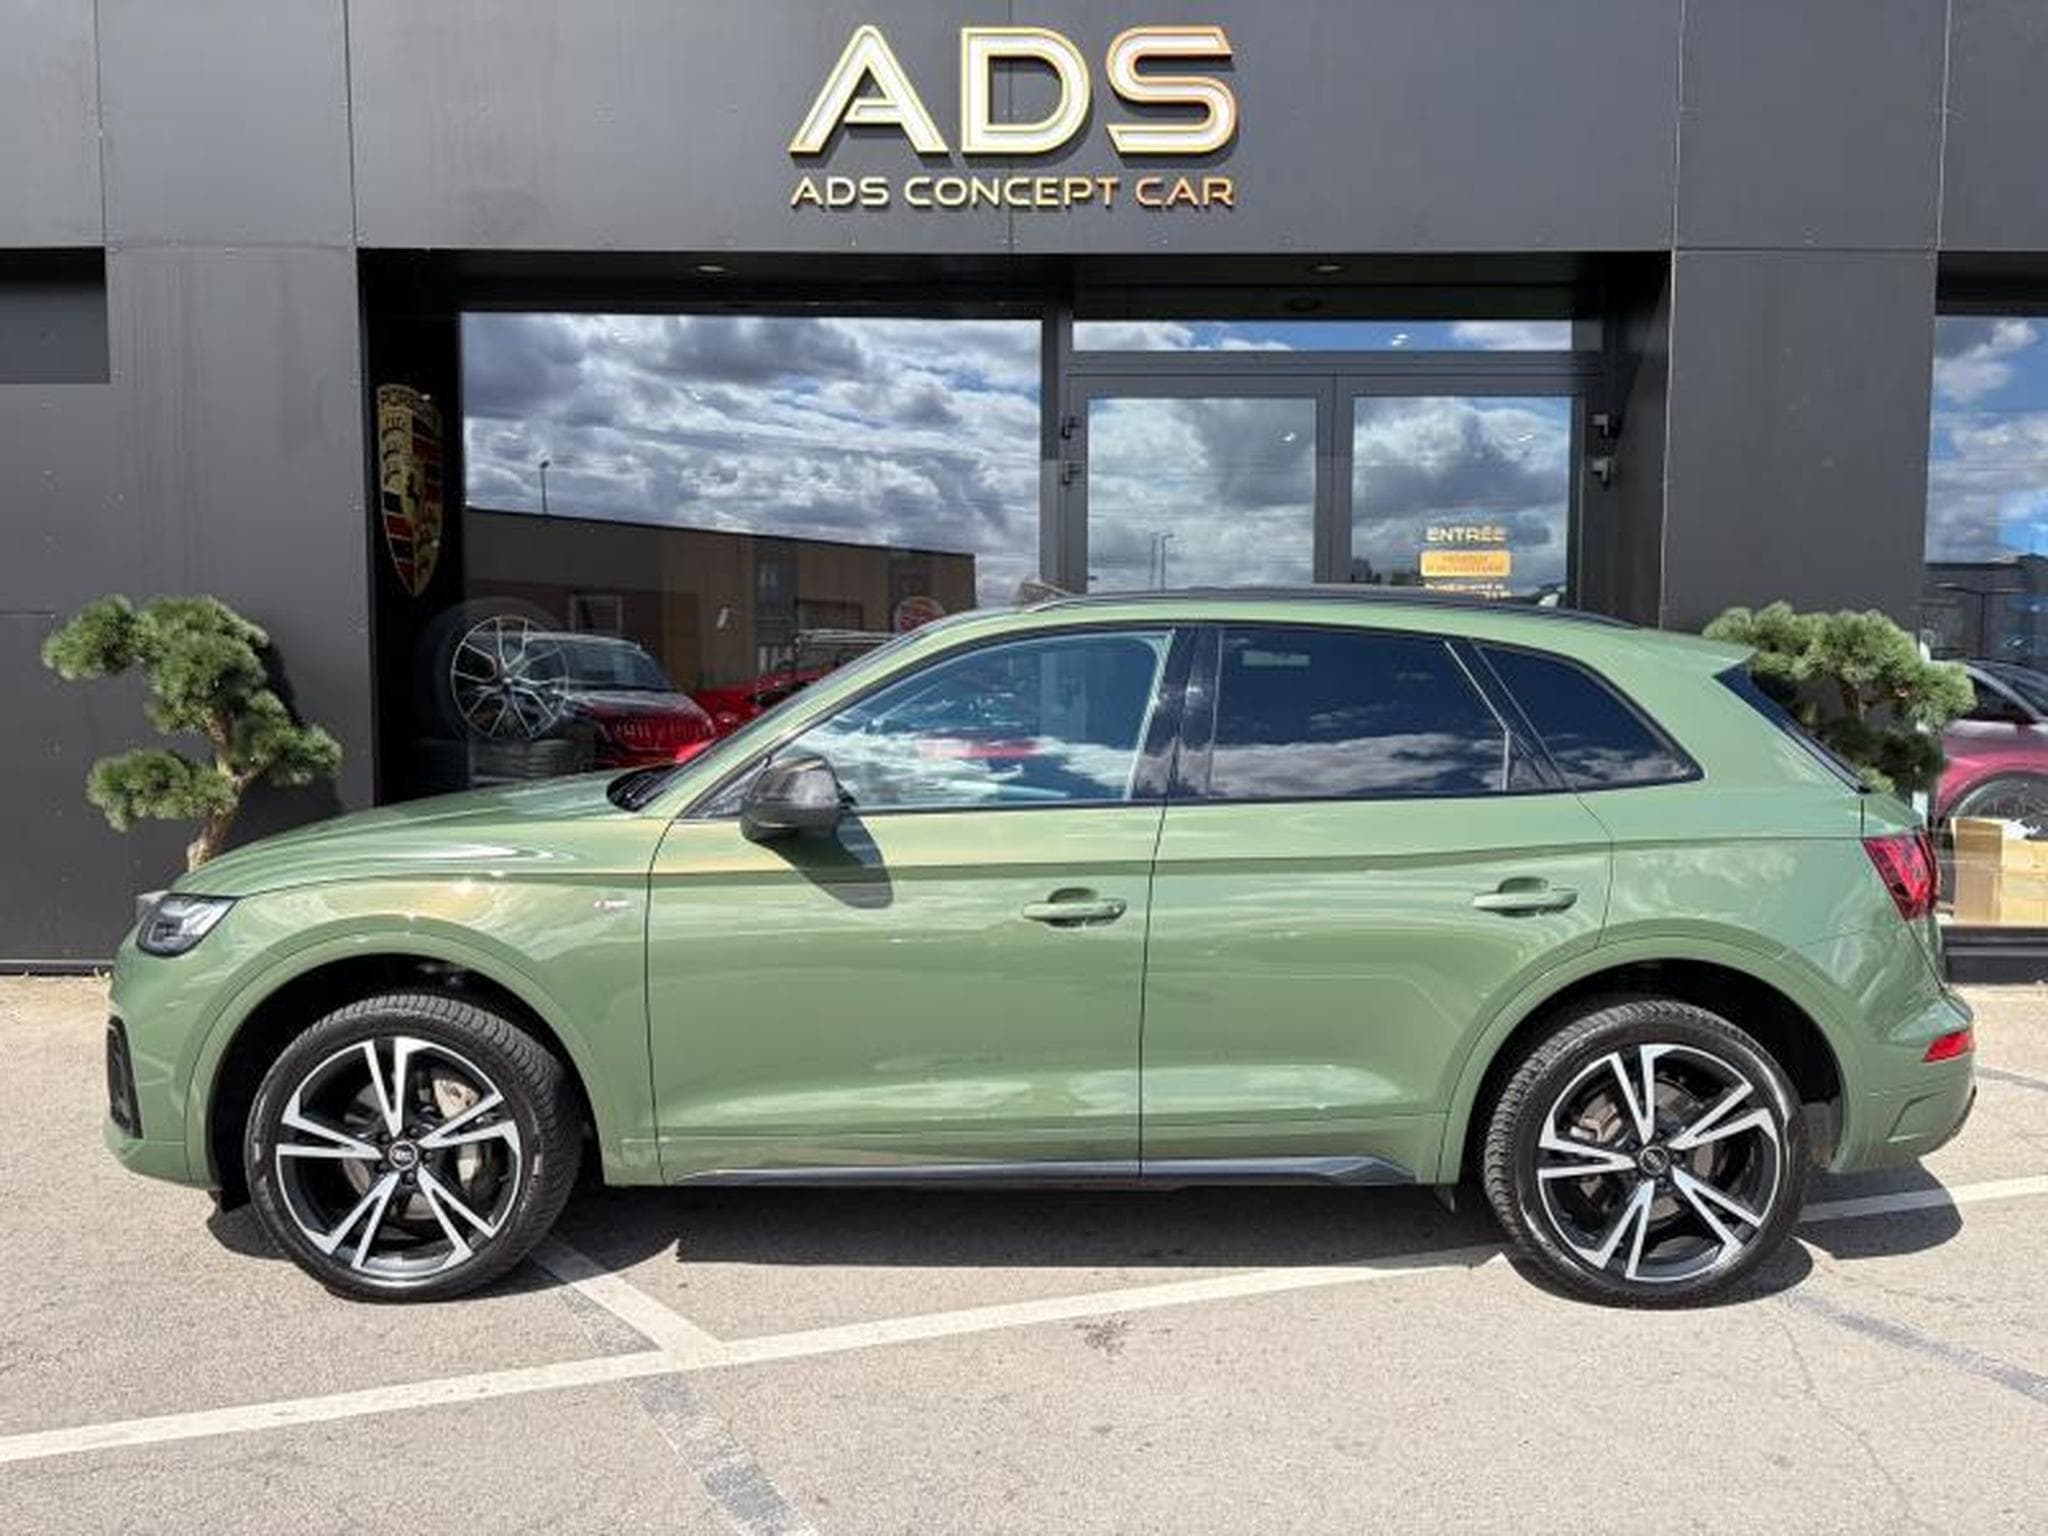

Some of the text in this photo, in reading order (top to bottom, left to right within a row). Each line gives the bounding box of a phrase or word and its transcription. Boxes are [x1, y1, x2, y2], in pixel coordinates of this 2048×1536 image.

[788, 25, 1237, 153] ADS
[791, 177, 1233, 206] ADS CONCEPT CAR
